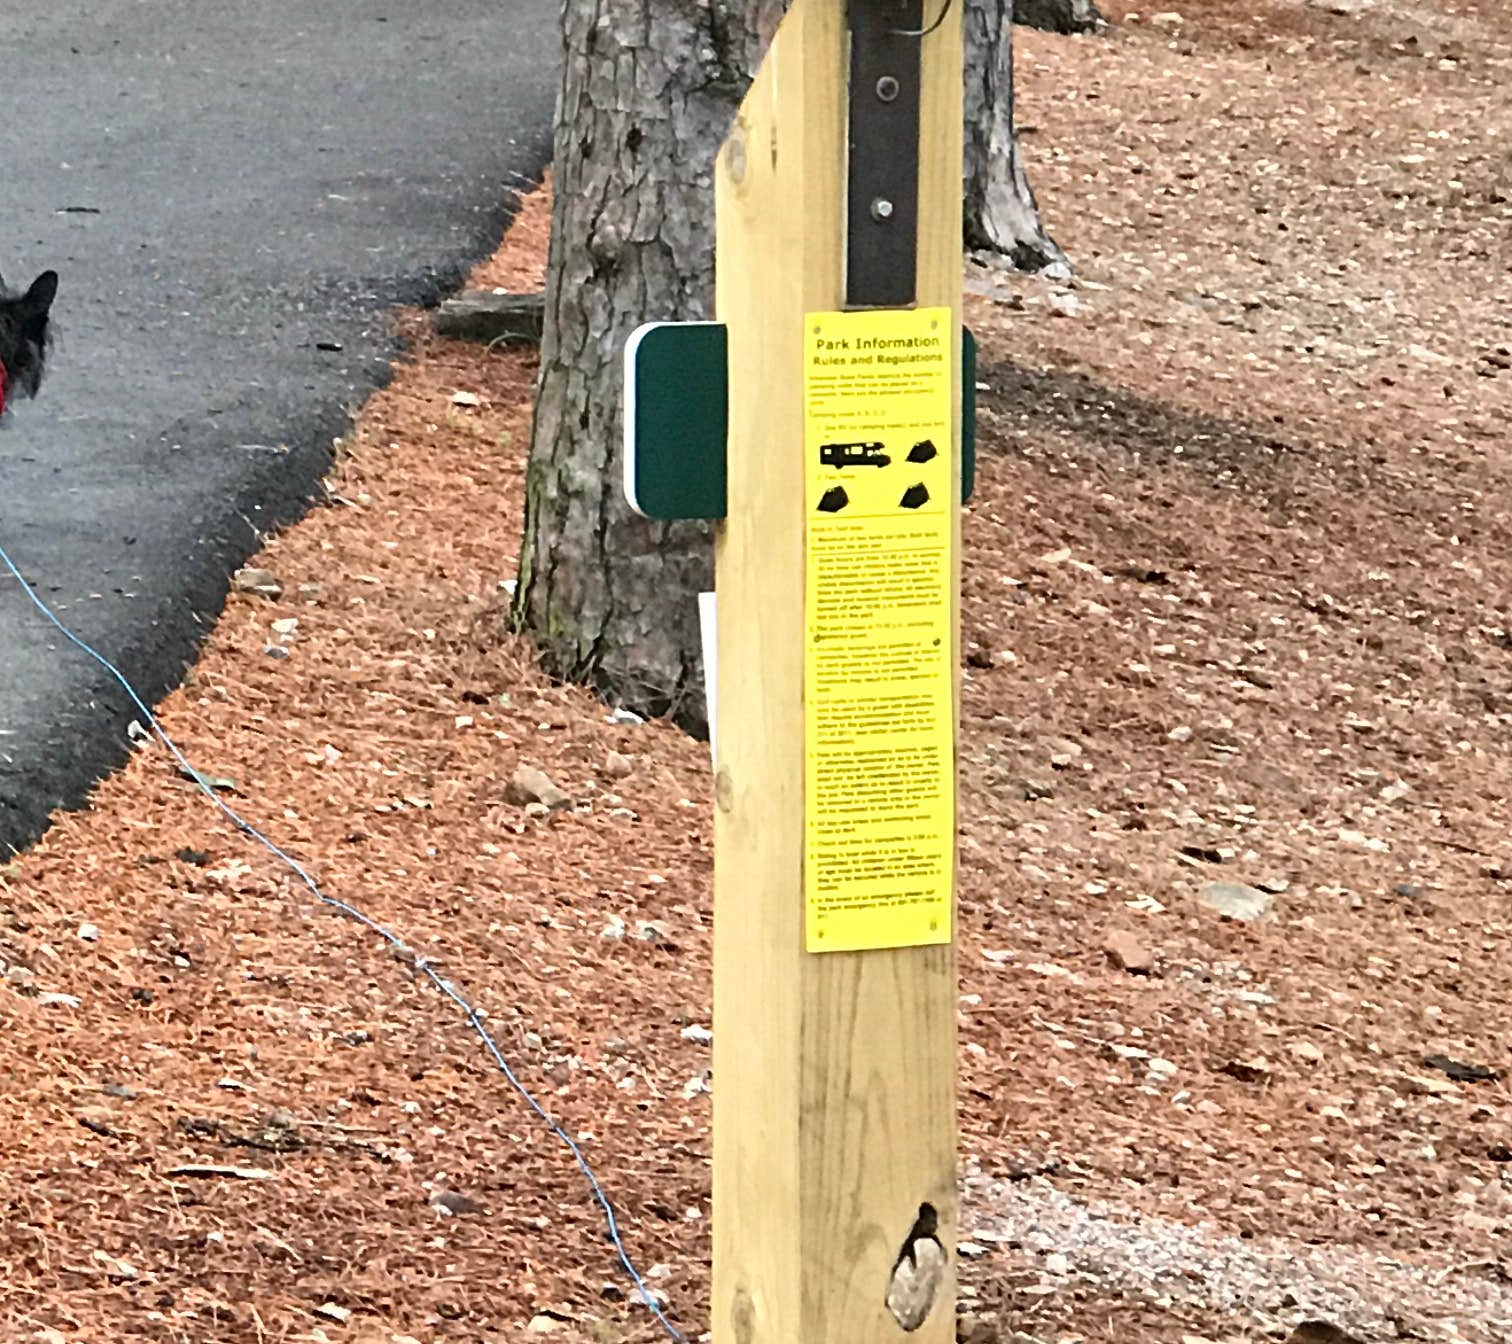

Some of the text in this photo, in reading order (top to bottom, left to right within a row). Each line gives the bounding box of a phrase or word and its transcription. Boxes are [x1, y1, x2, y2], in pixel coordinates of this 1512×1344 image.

[816, 337, 940, 350] Park Information
[813, 354, 943, 365] Rules and Regulations
